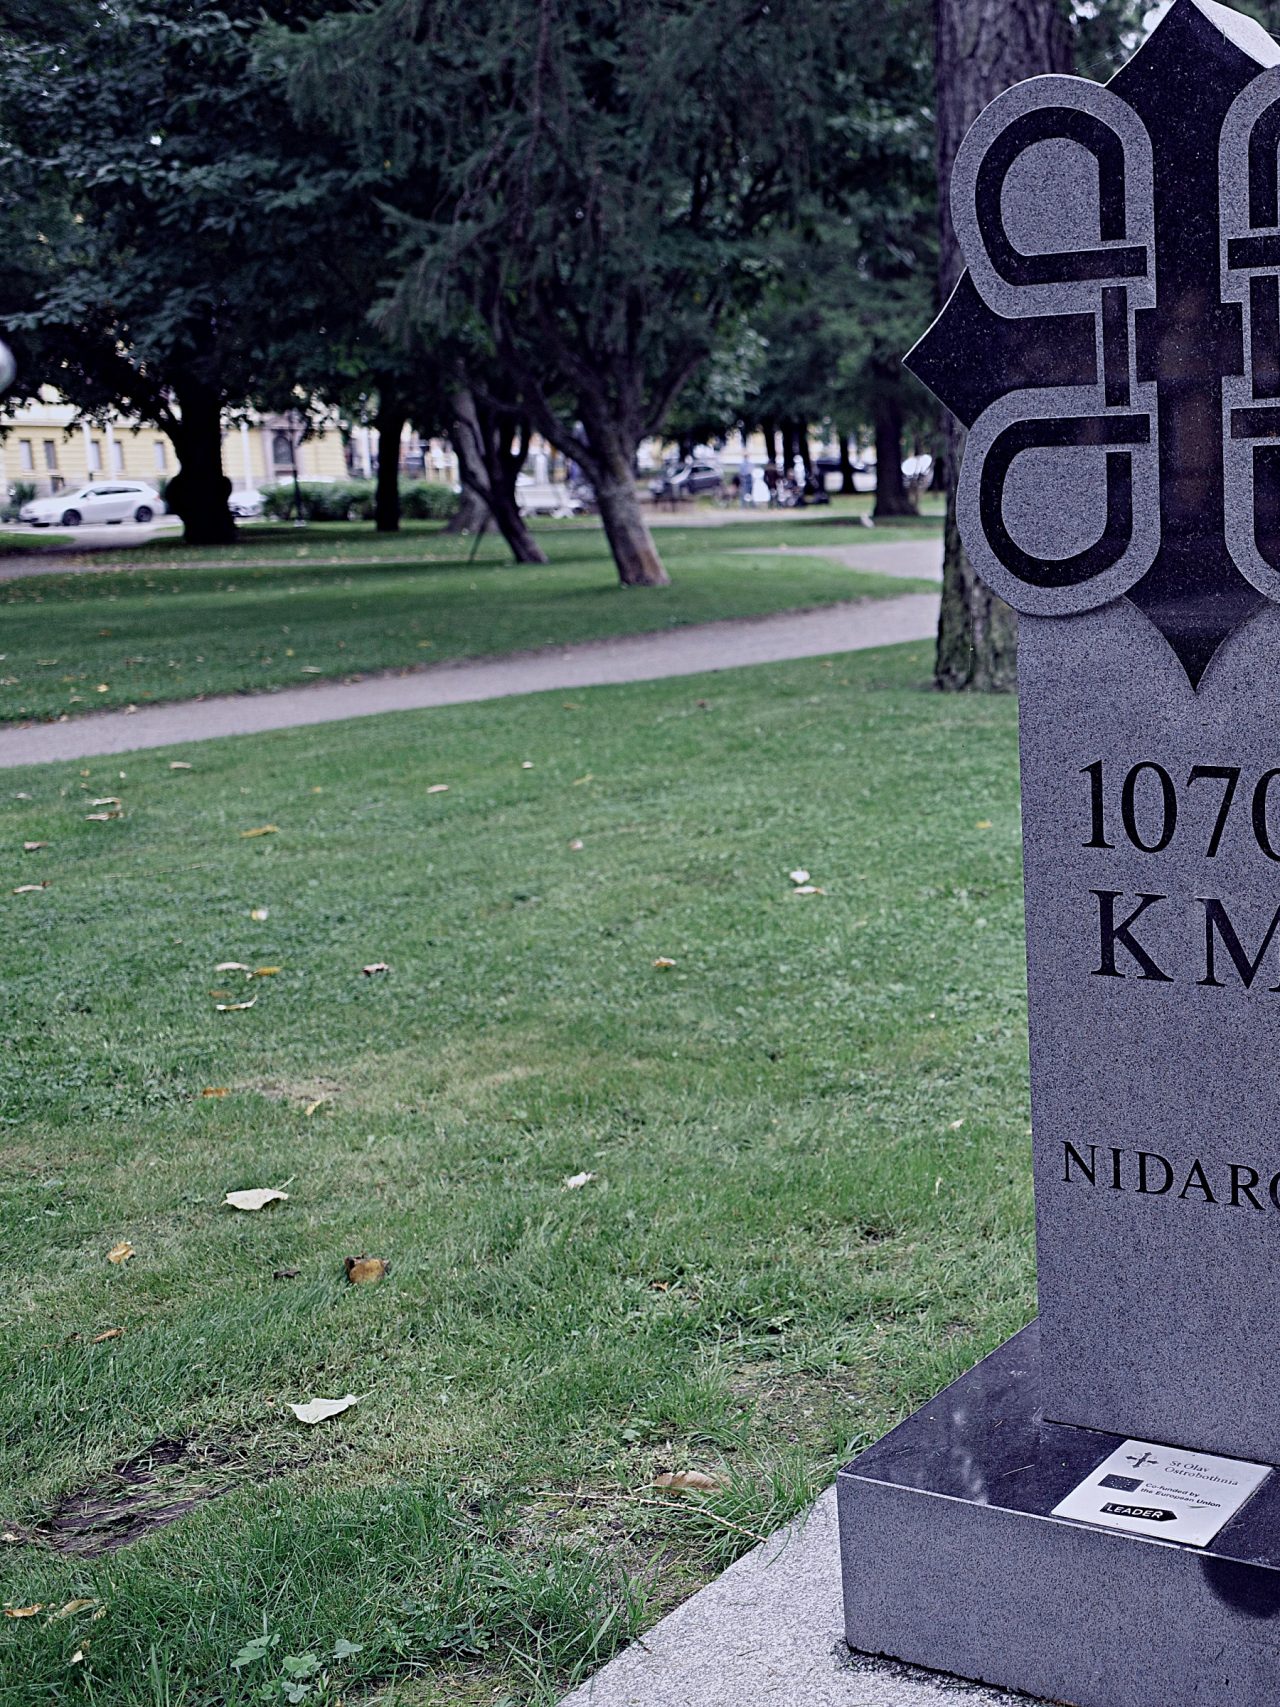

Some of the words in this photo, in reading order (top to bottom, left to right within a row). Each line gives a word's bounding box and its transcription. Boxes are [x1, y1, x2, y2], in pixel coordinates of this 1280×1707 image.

[1169, 1460, 1183, 1468] St
[1183, 1462, 1210, 1474] Olav
[1164, 1466, 1240, 1487] Ostrobothnia
[1145, 1483, 1189, 1496] Co-funded
[1140, 1487, 1154, 1495] the
[1155, 1490, 1195, 1504] European
[1196, 1498, 1222, 1509] Union
[1106, 1504, 1165, 1520] LEADER
